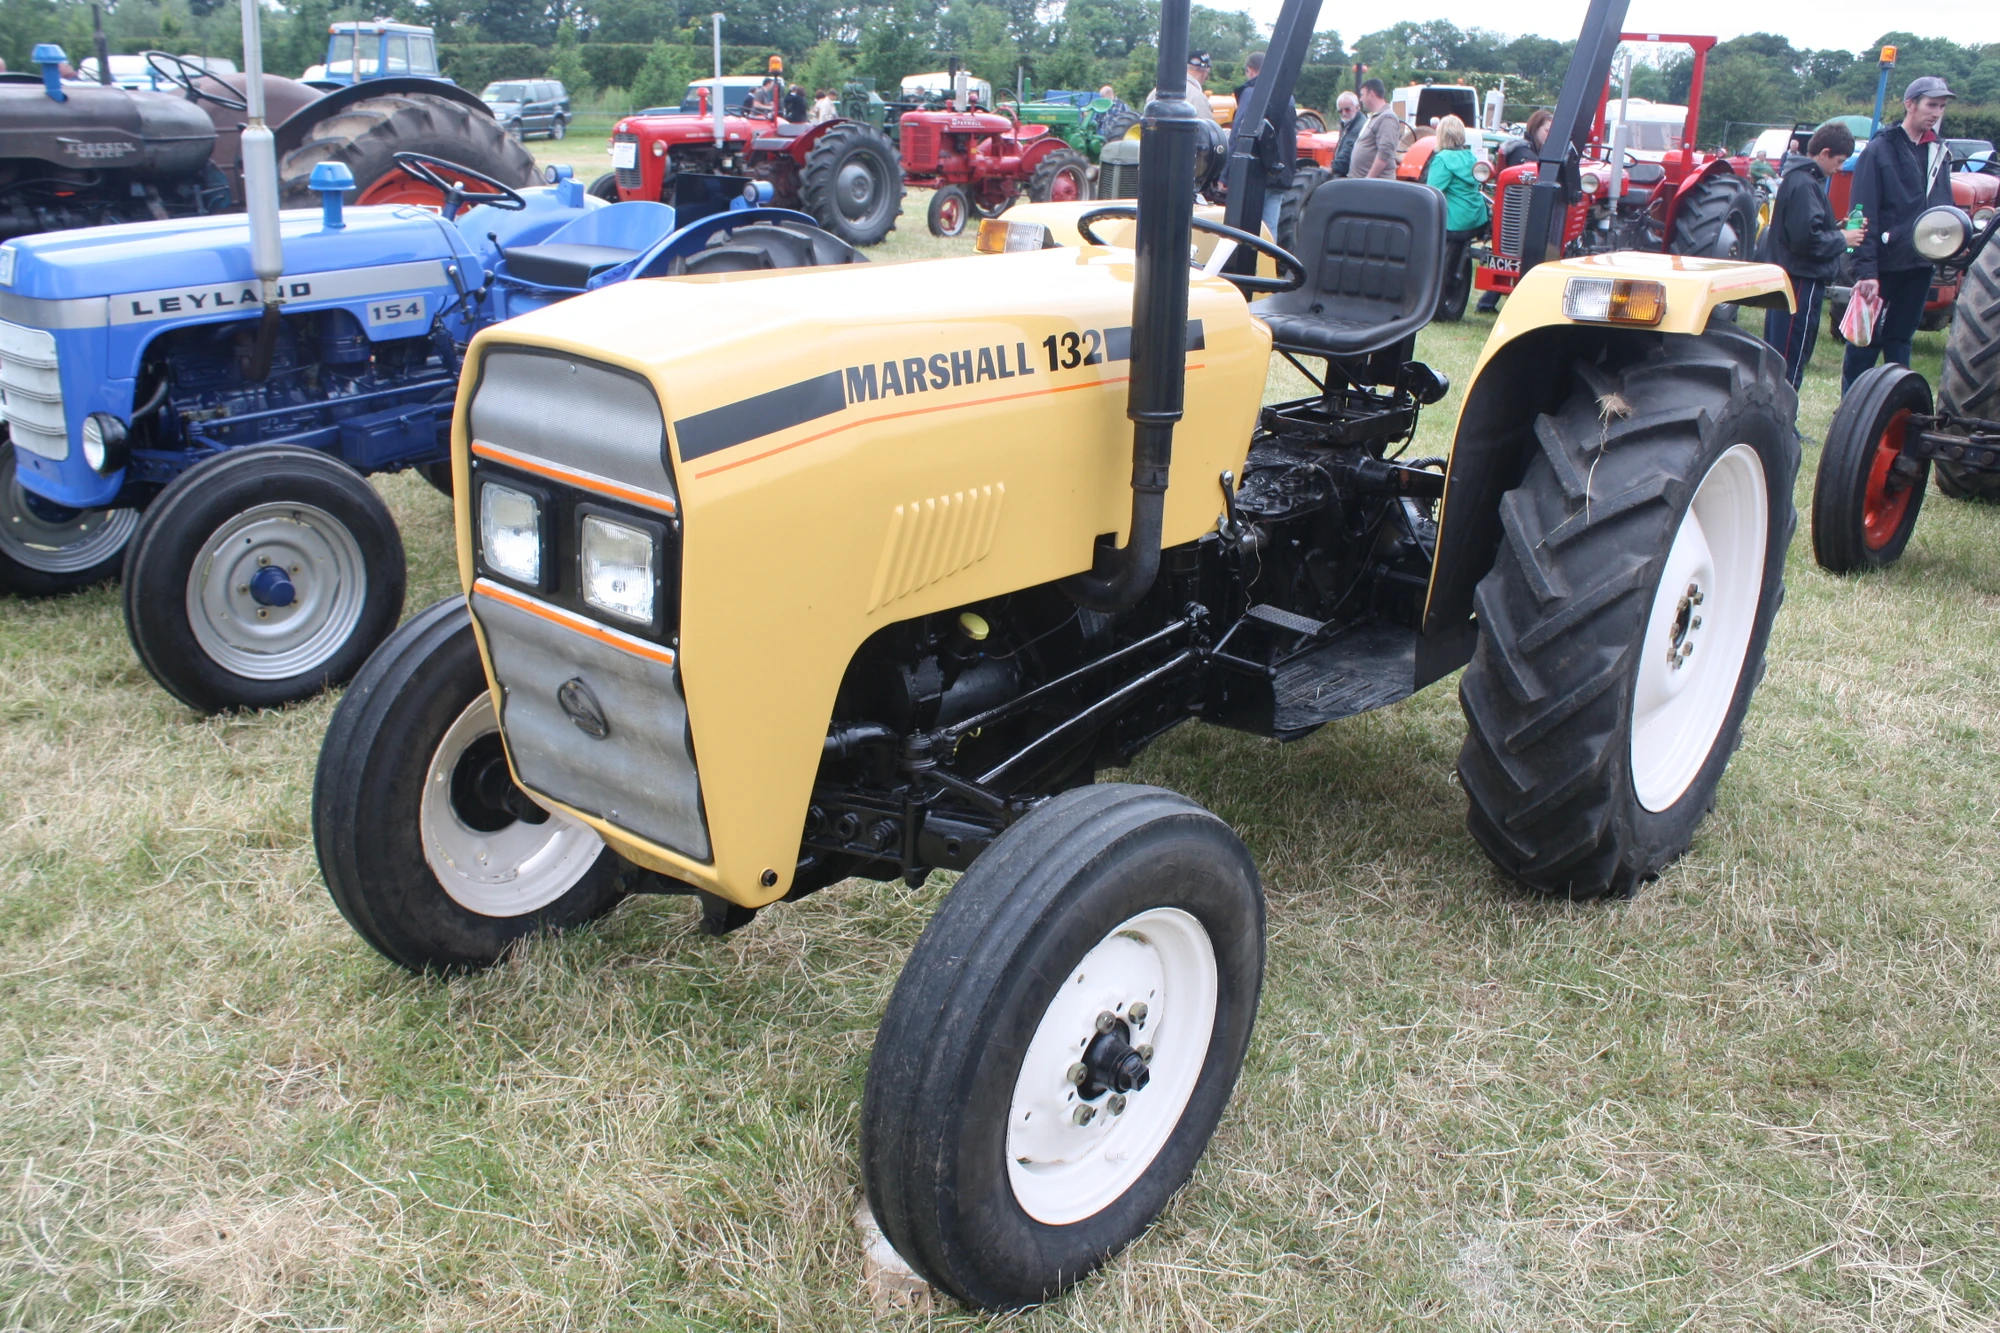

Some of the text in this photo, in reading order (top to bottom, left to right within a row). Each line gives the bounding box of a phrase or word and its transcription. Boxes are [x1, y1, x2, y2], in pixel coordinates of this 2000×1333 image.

[372, 302, 421, 321] 154
[846, 329, 1103, 404] MARSHALL 132
